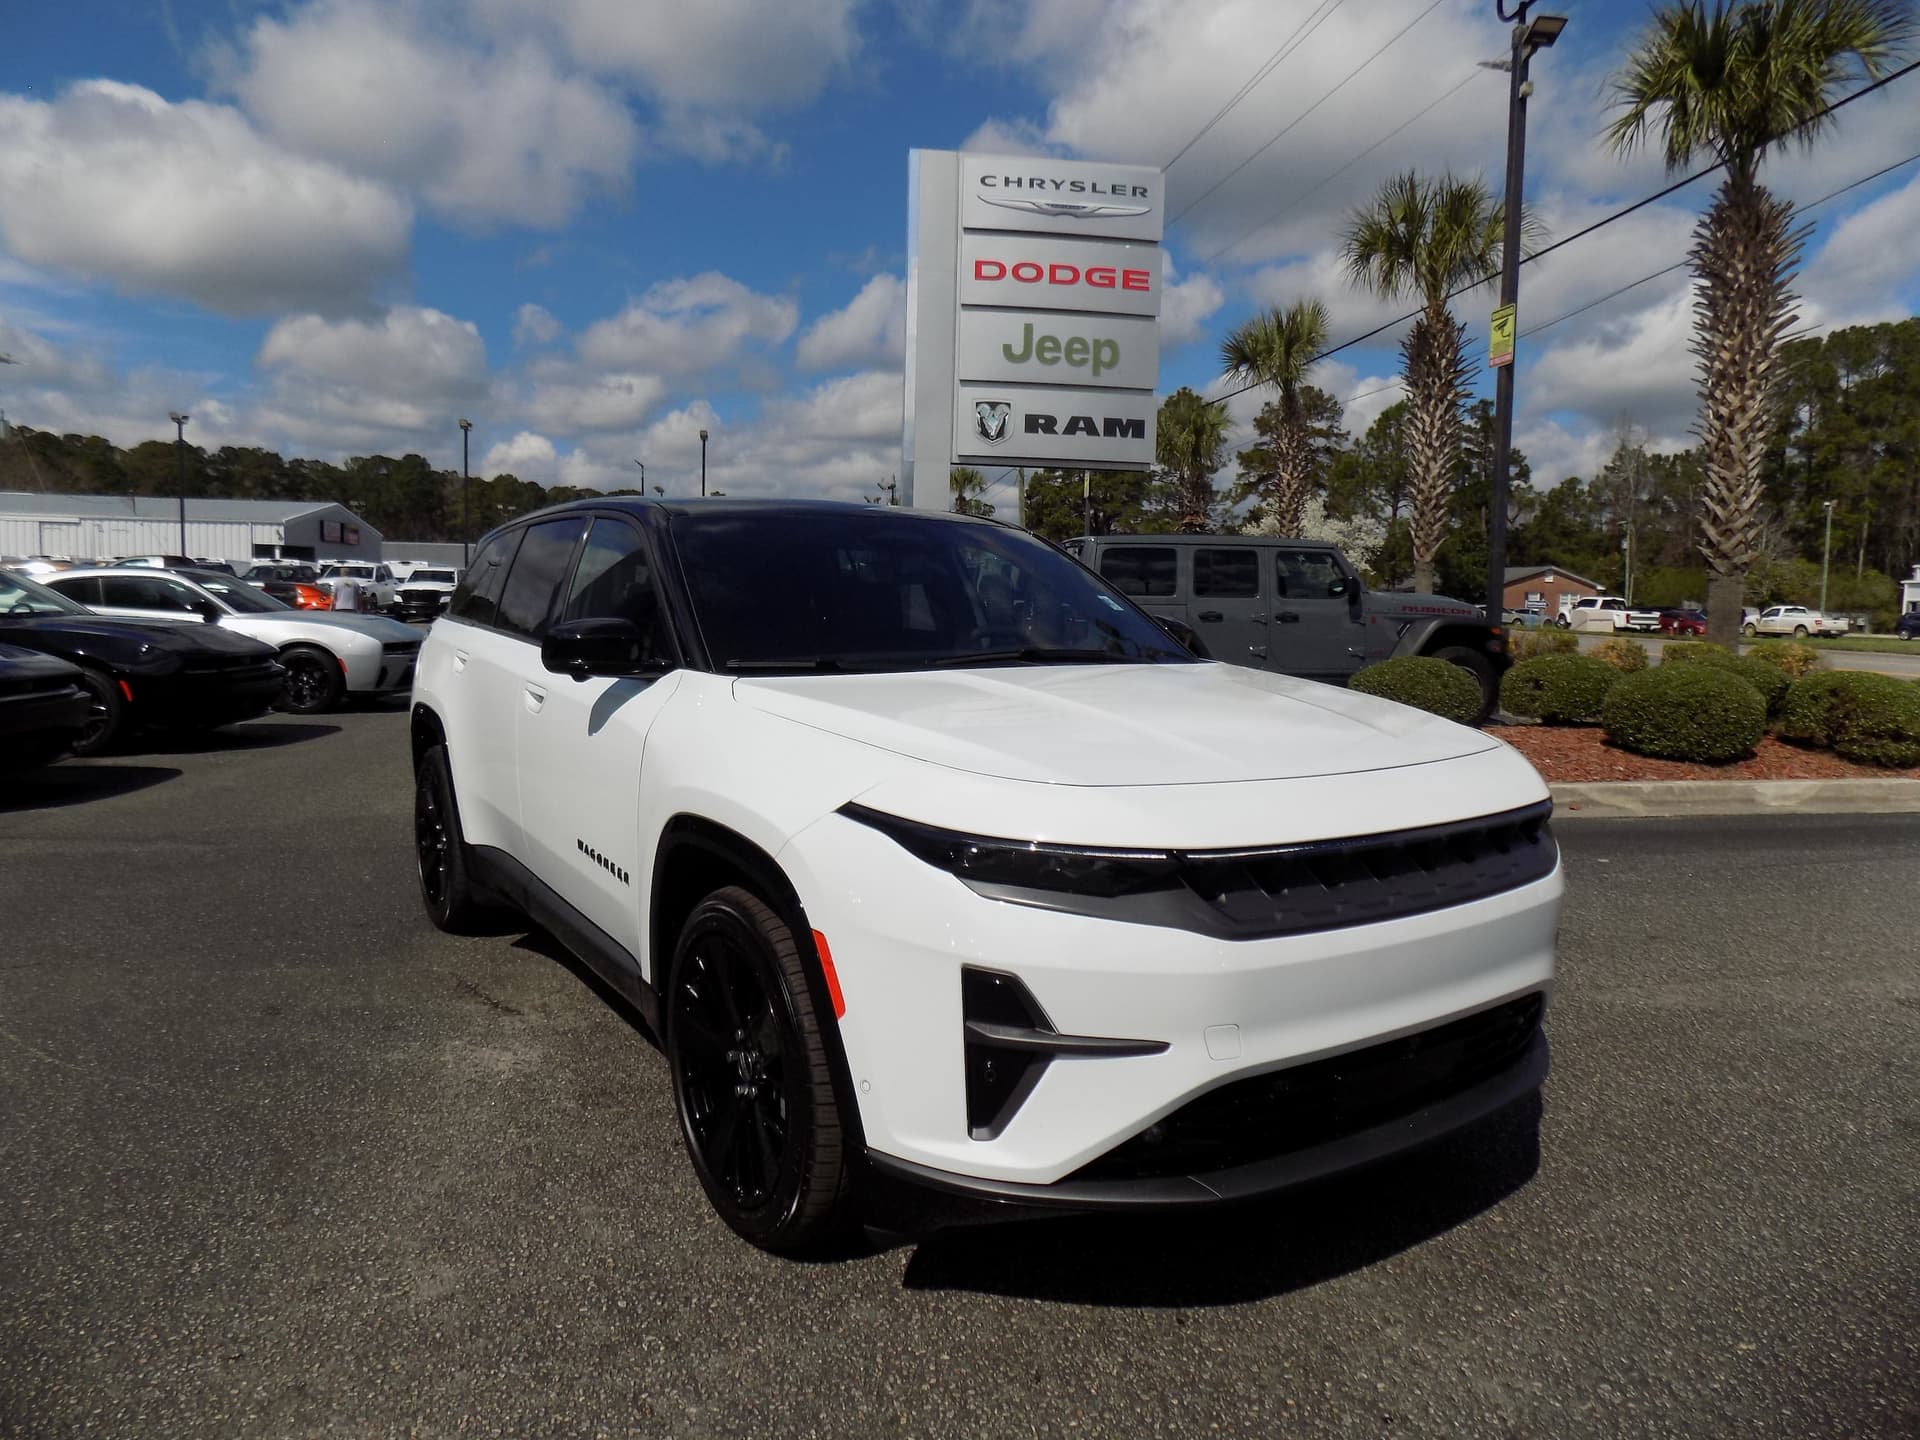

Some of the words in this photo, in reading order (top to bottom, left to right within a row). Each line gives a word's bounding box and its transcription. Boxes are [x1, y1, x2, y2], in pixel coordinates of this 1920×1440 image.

[979, 175, 1148, 198] CHRYSLER
[974, 260, 1150, 291] DODGE
[1002, 323, 1120, 376] Jeep
[1024, 414, 1145, 439] RAM
[1402, 605, 1472, 615] RUBICON
